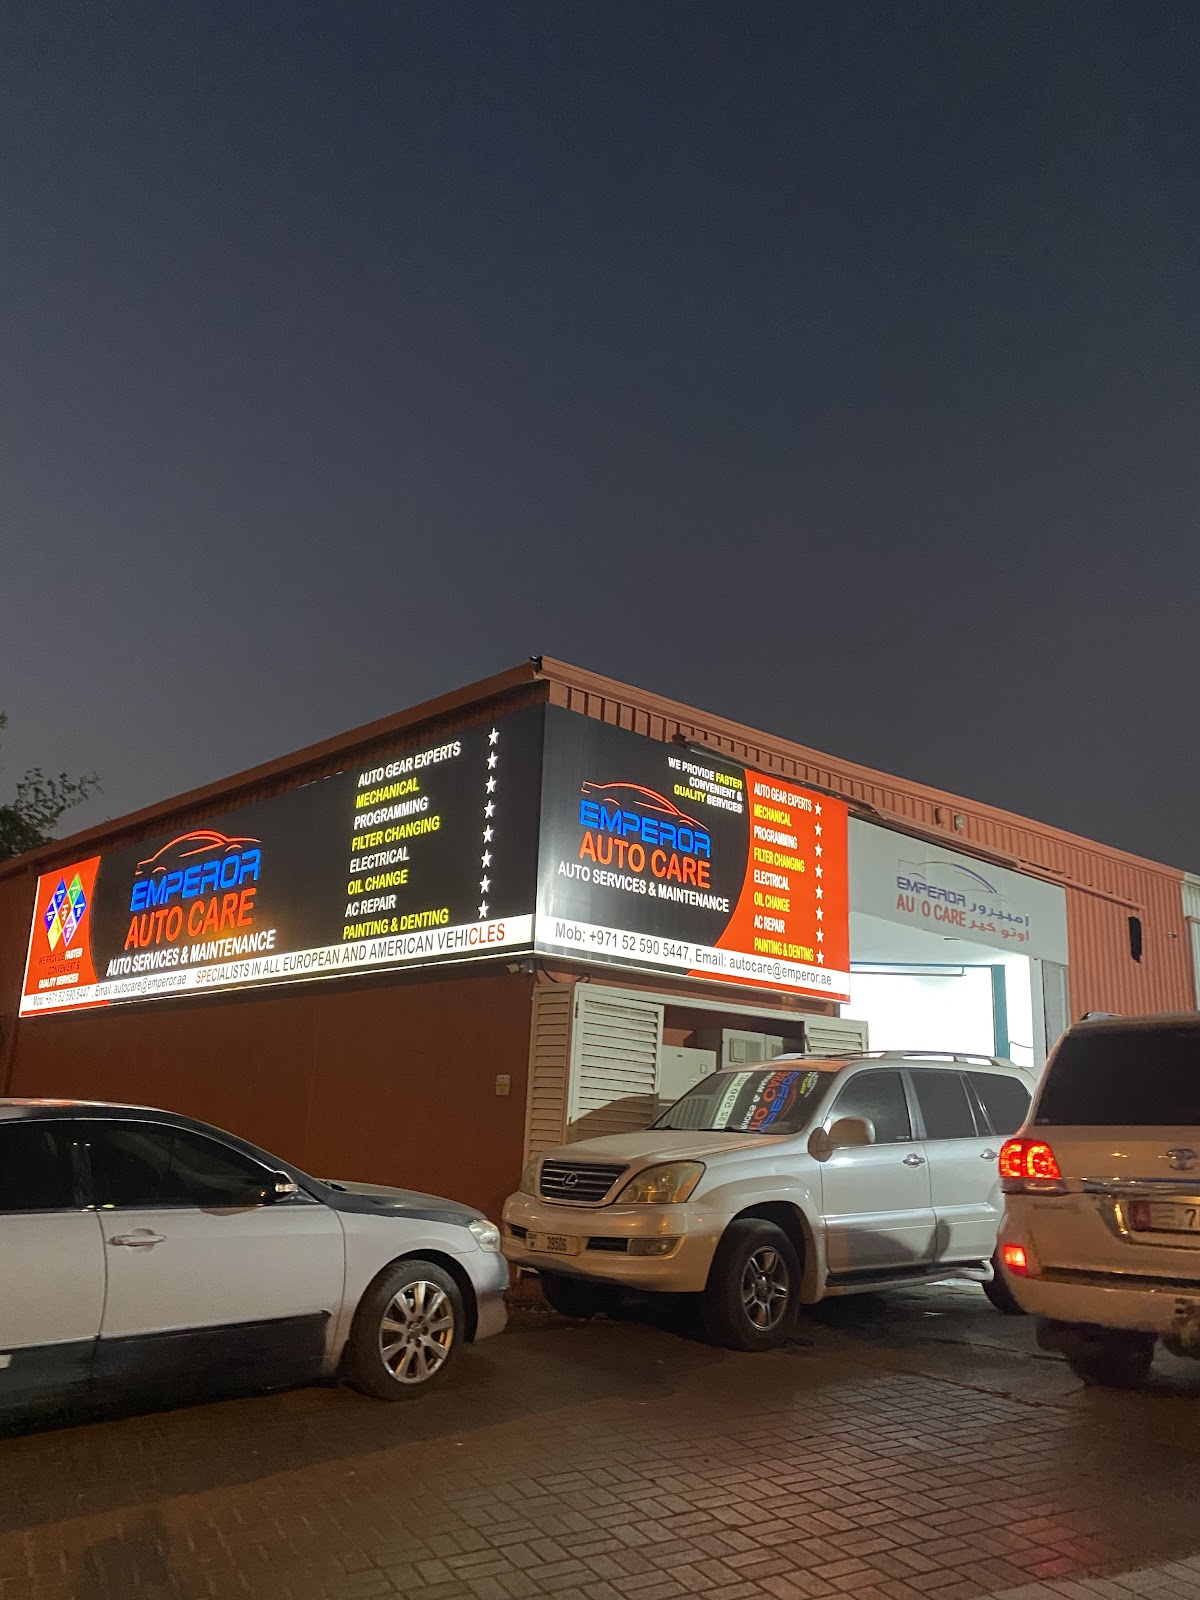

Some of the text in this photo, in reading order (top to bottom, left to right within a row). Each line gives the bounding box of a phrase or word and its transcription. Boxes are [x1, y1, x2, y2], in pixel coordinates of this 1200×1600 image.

[358, 741, 462, 788] AUTO GEAR EXPERTS
[668, 756, 742, 790] WE PROVIDE FASTER
[356, 777, 420, 809] MECHANICAL
[674, 784, 742, 814] QUALITY SERVICES
[689, 776, 742, 802] CONVENIENT &
[754, 782, 812, 812] AUTO GEAR EXPERTS
[354, 796, 429, 830] PROGRAMMING
[754, 804, 792, 826] MECHANICAL
[352, 816, 441, 852] FILTER CHANGING
[580, 800, 711, 858] EMPEROR
[754, 825, 798, 850] PROGRAMMING
[350, 846, 410, 874] ELECTRICAL
[579, 831, 711, 888] AUTO CARE
[754, 847, 805, 872] FILTER CHANGING
[130, 848, 261, 912] EMPEROR
[348, 868, 408, 895] OIL CHANGE
[558, 861, 730, 913] AUTO SERVICES & MAINTENANCE
[754, 869, 790, 890] ELECTRICAL
[896, 876, 966, 907] EMPEROR
[345, 894, 396, 918] AC REPAIR
[754, 892, 790, 912] OIL CHANGE
[934, 904, 966, 927] CARE
[124, 905, 182, 950] AUTO
[188, 888, 257, 937] CARE
[343, 908, 450, 940] PAINTING & DENTING
[754, 914, 785, 934] AC REPAIR
[106, 929, 277, 977] AUTO SERVICES & MAINTENANCE
[196, 923, 505, 984] SPECIALISTS IN ALL EUROPEAN AND AMERICAN VEHICLES
[555, 922, 586, 942] Mob:
[590, 930, 617, 948] +971
[622, 935, 636, 951] 52
[640, 938, 660, 955] 590
[695, 948, 726, 967] Email:
[730, 956, 832, 986] autocare@emperor.ae
[754, 937, 814, 962] PAINTING & DENTING
[114, 974, 186, 994] autocare@emperor.ae
